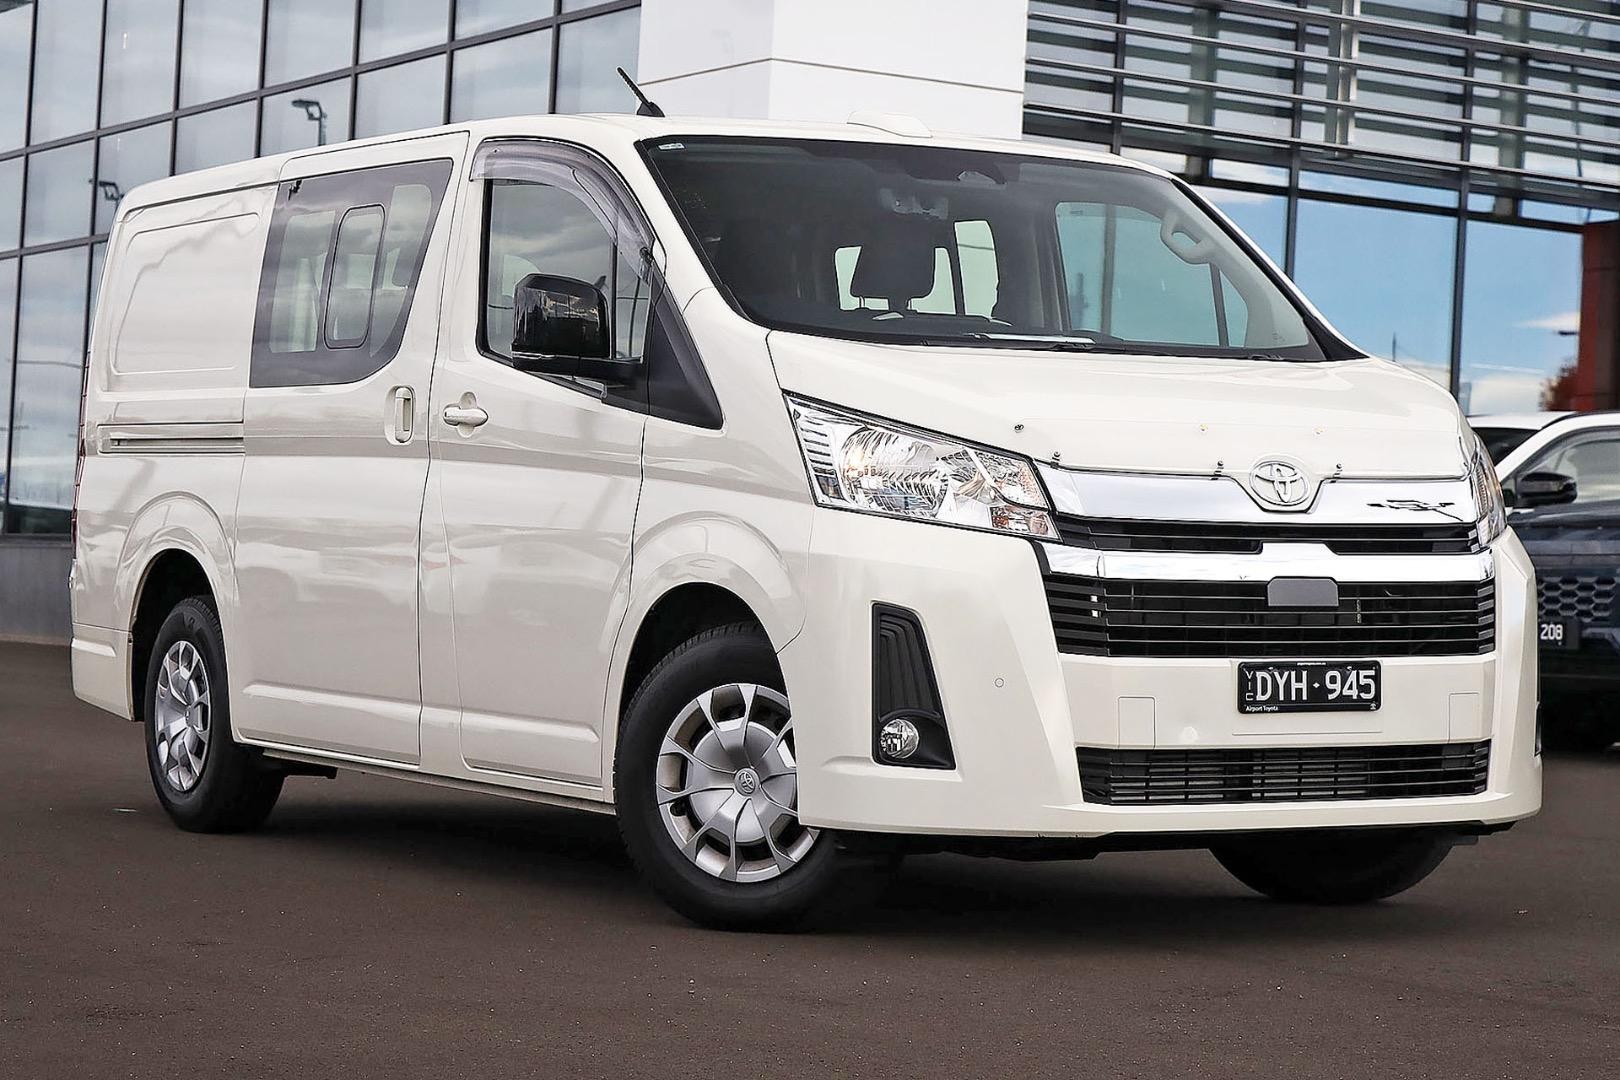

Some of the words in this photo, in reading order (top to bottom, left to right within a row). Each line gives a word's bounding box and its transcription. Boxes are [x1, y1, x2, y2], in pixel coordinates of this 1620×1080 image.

[1540, 623, 1563, 640] 208
[1244, 668, 1254, 701] VIC
[1255, 670, 1308, 701] DYH
[1325, 670, 1375, 700] 945
